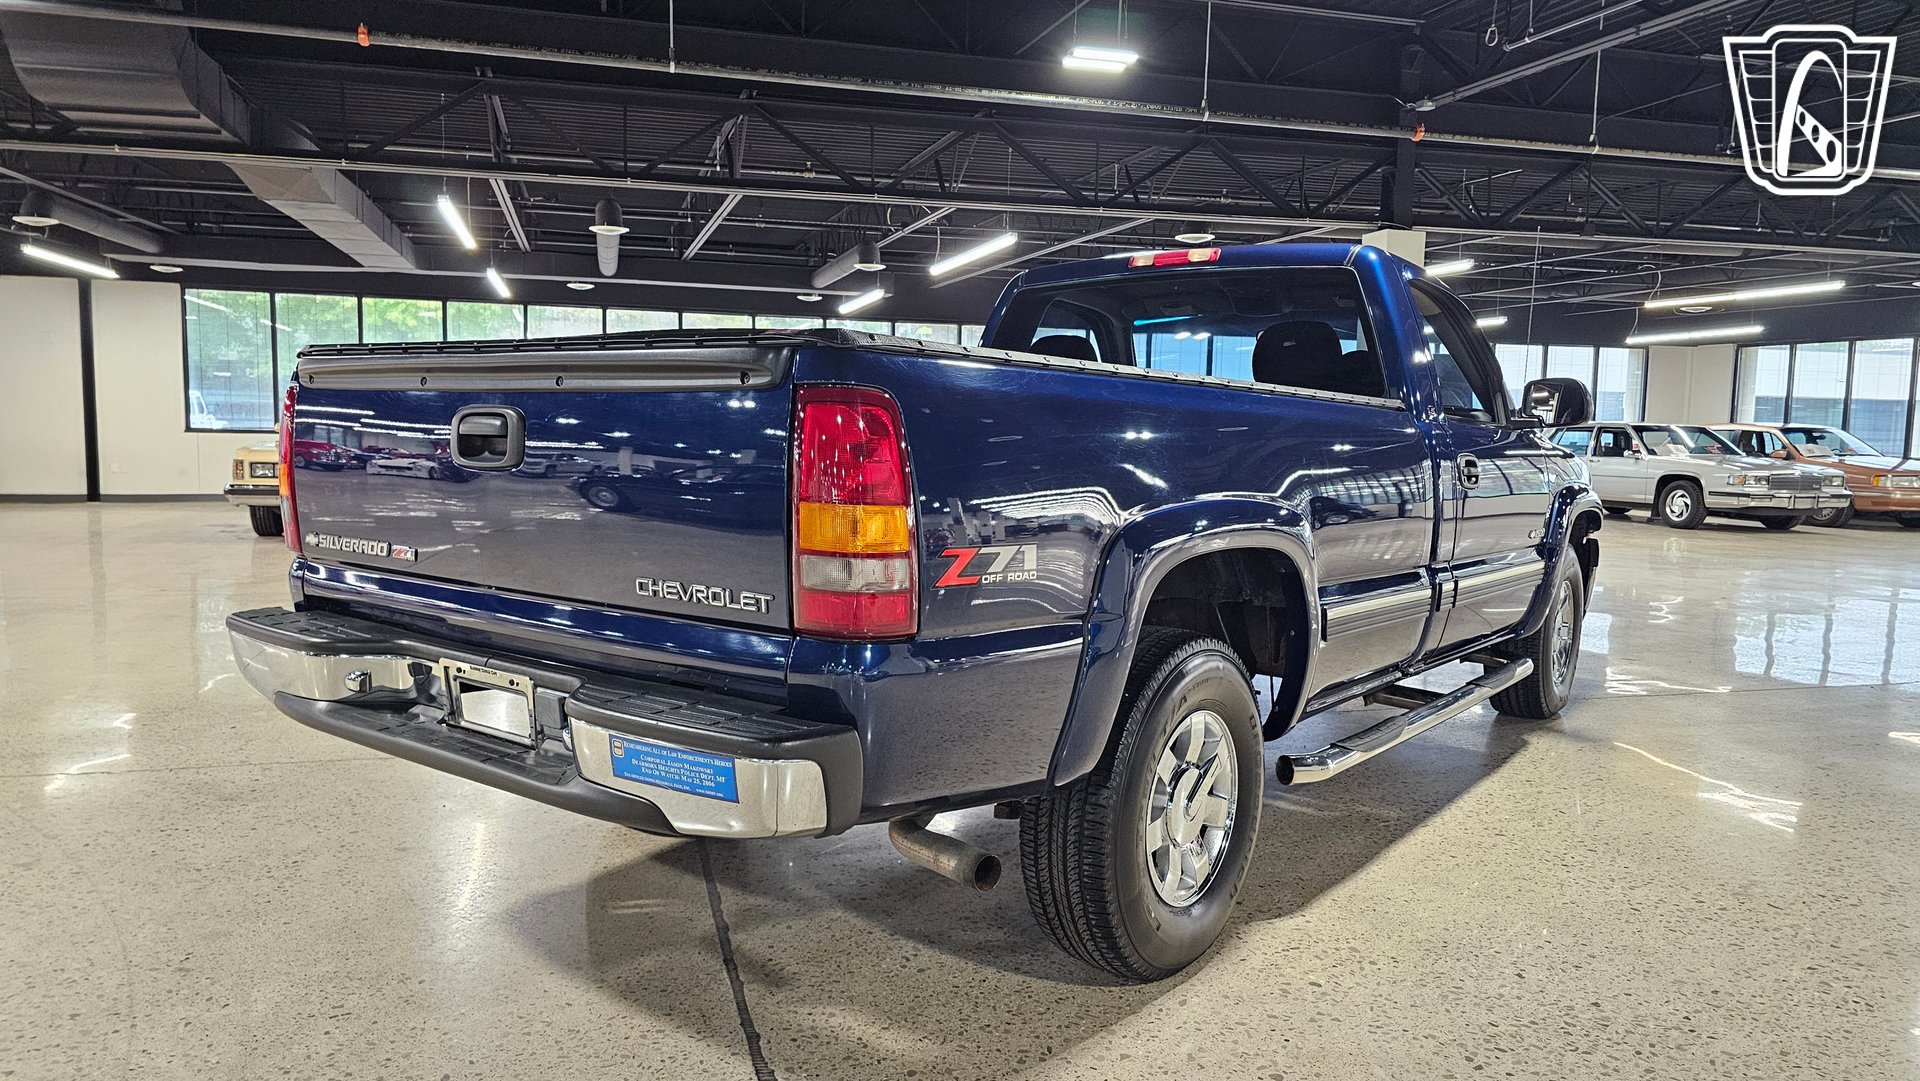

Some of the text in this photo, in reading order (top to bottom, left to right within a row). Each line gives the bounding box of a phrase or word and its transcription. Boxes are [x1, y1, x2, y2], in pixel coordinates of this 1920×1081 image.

[319, 534, 391, 557] SILVERADO
[934, 544, 1038, 588] Z71
[982, 571, 1037, 584] OFF ROAD
[635, 577, 775, 614] CHEVROLET
[631, 758, 657, 769] DEARBORN
[657, 763, 679, 773] HEIGHTS
[679, 768, 699, 777] POLICE
[640, 754, 665, 764] CORPORAL
[667, 759, 682, 768] JASON
[641, 766, 652, 774] END
